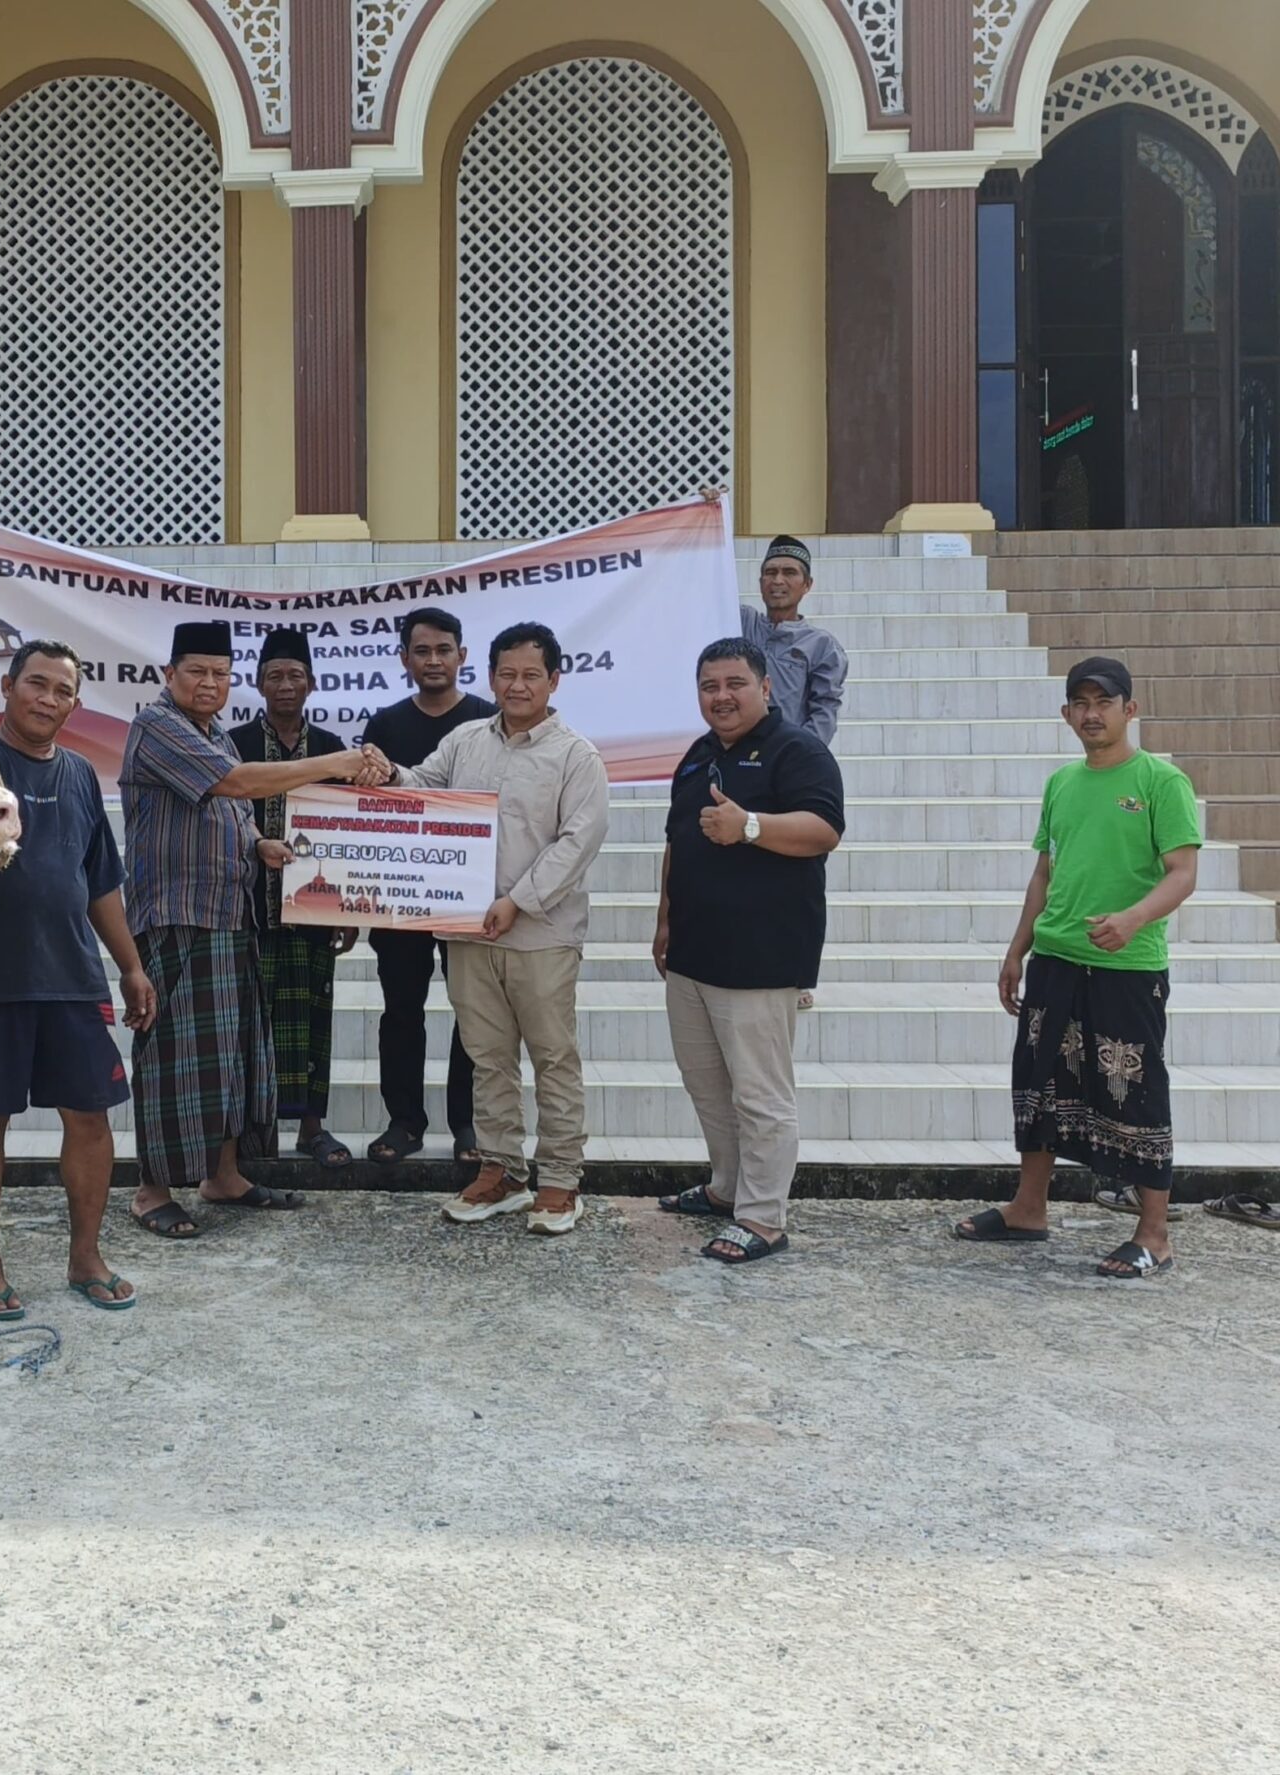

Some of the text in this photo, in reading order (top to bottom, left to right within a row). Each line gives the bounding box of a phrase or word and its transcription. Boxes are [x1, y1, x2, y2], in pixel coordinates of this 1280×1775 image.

[479, 549, 643, 590] PRESIDEN
[314, 671, 389, 691] DHA
[559, 650, 614, 673] 024
[358, 798, 424, 814] BANTUAN
[291, 815, 492, 838] KEMASYARAKATAN PRESIDEN
[313, 842, 467, 866] BERUPA SAPI
[347, 870, 425, 883] DALAM RANGKA
[308, 883, 464, 901] HARI RAYA IDUL ADHA
[338, 903, 370, 914] 1445
[375, 904, 386, 914] H
[398, 904, 431, 917] 2024
